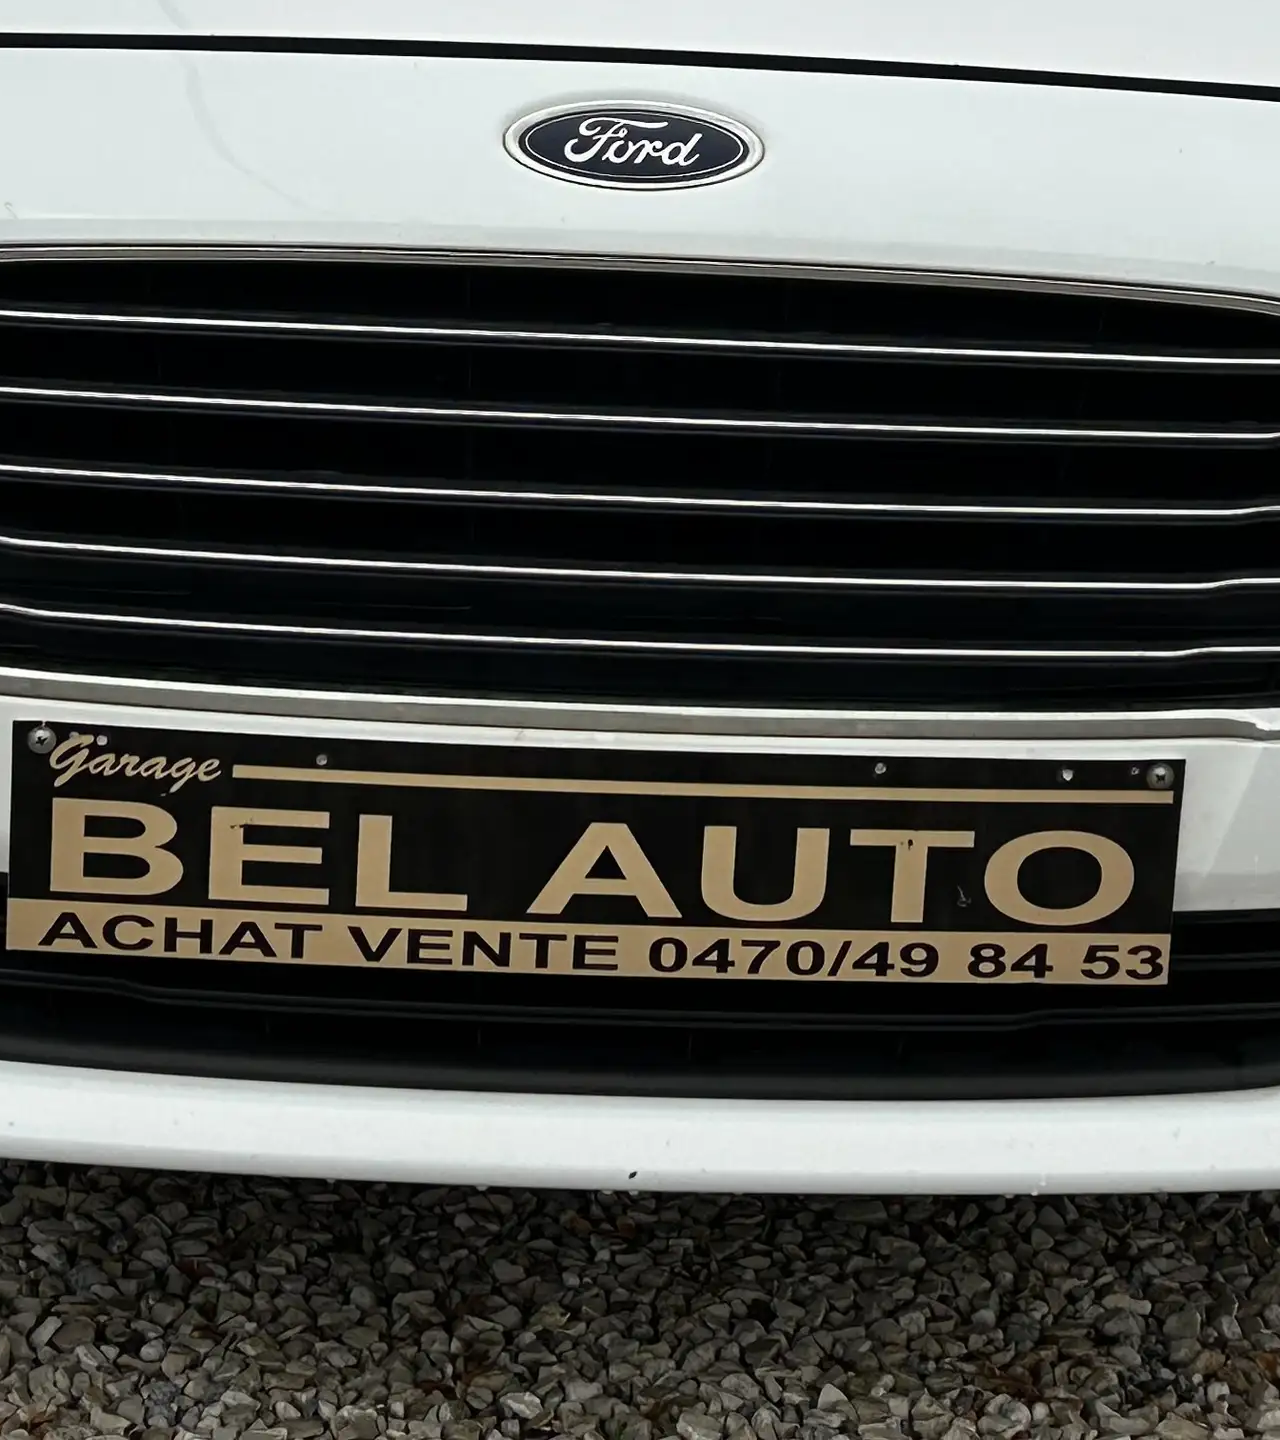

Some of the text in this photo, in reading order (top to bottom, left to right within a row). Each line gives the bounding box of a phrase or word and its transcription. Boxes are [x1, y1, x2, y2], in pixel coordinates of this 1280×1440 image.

[564, 116, 702, 167] Ford
[49, 731, 222, 794] Garage
[49, 797, 1136, 927] BEL AUTO
[36, 911, 1164, 981] ACHAT VENTE 0470/49 84 53
